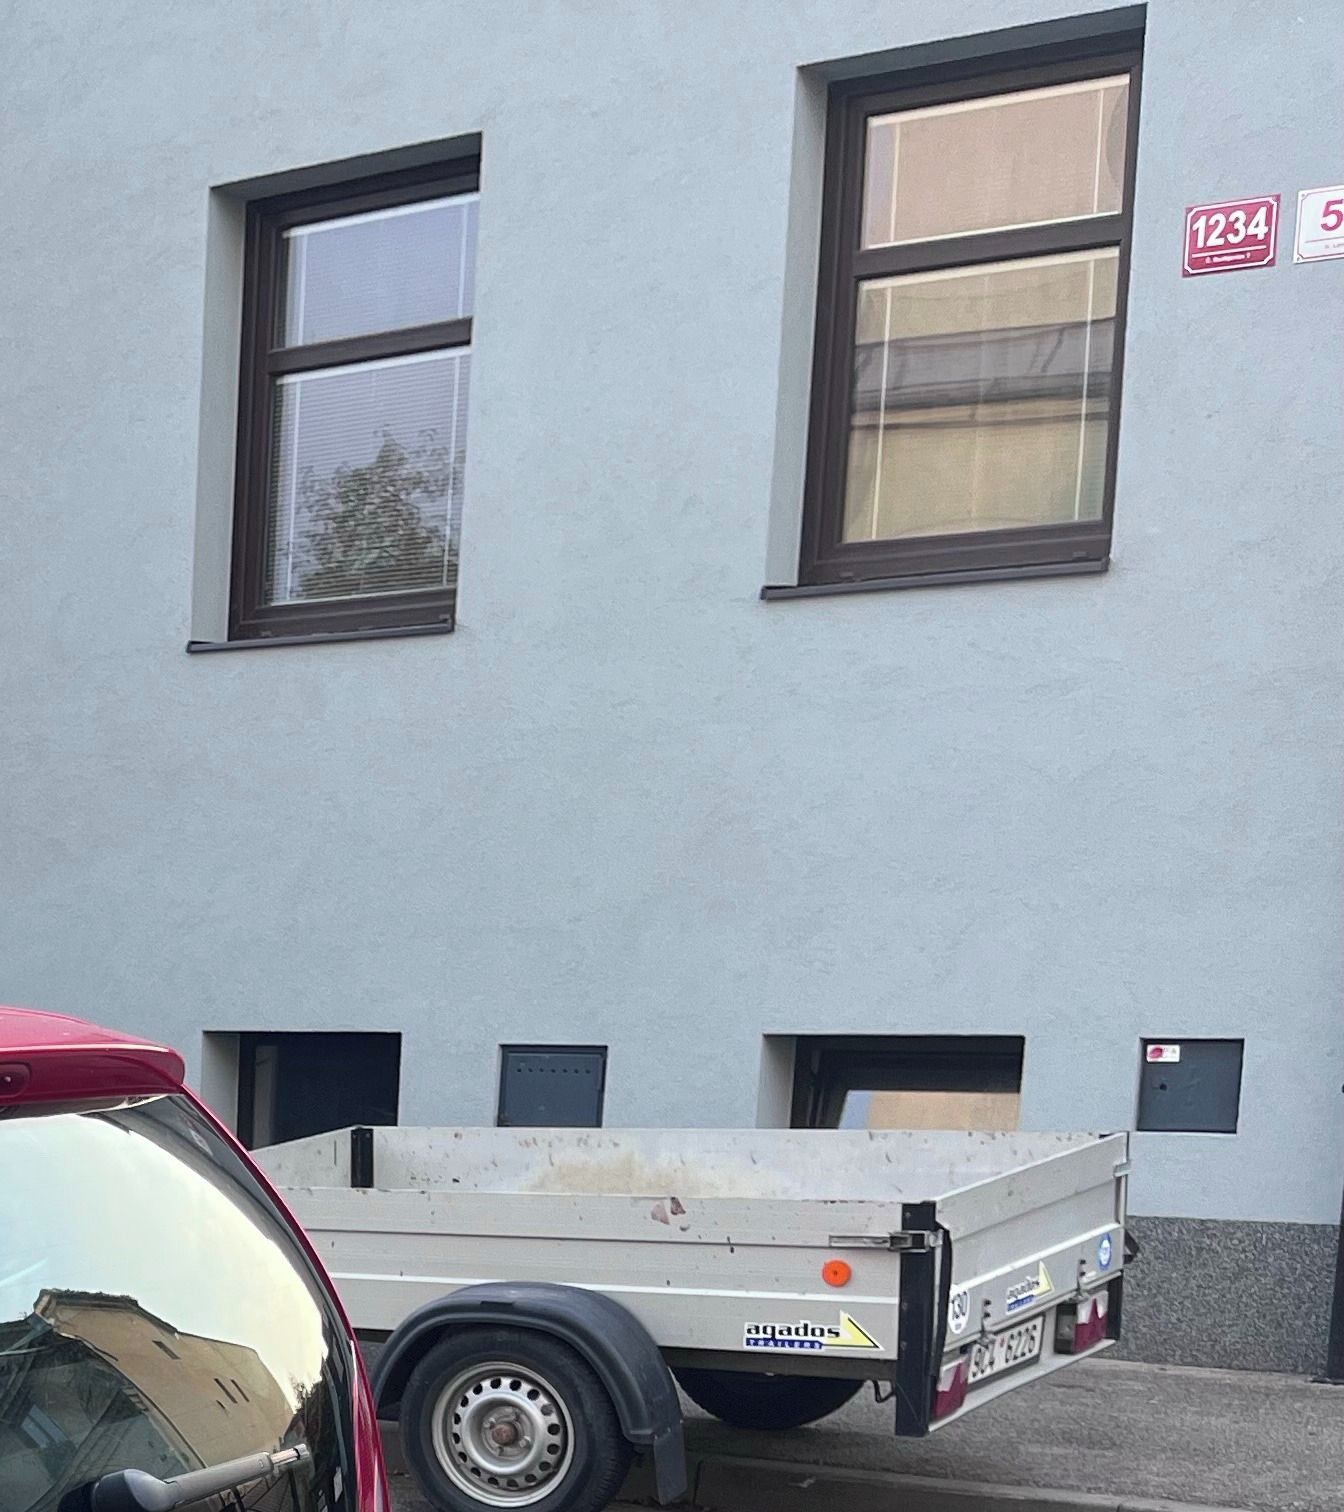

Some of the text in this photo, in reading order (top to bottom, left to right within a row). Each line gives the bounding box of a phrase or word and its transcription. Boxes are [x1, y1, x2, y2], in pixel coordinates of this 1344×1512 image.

[1192, 206, 1269, 249] 1234
[746, 1322, 841, 1340] agados
[749, 1338, 821, 1350] TRAILERS
